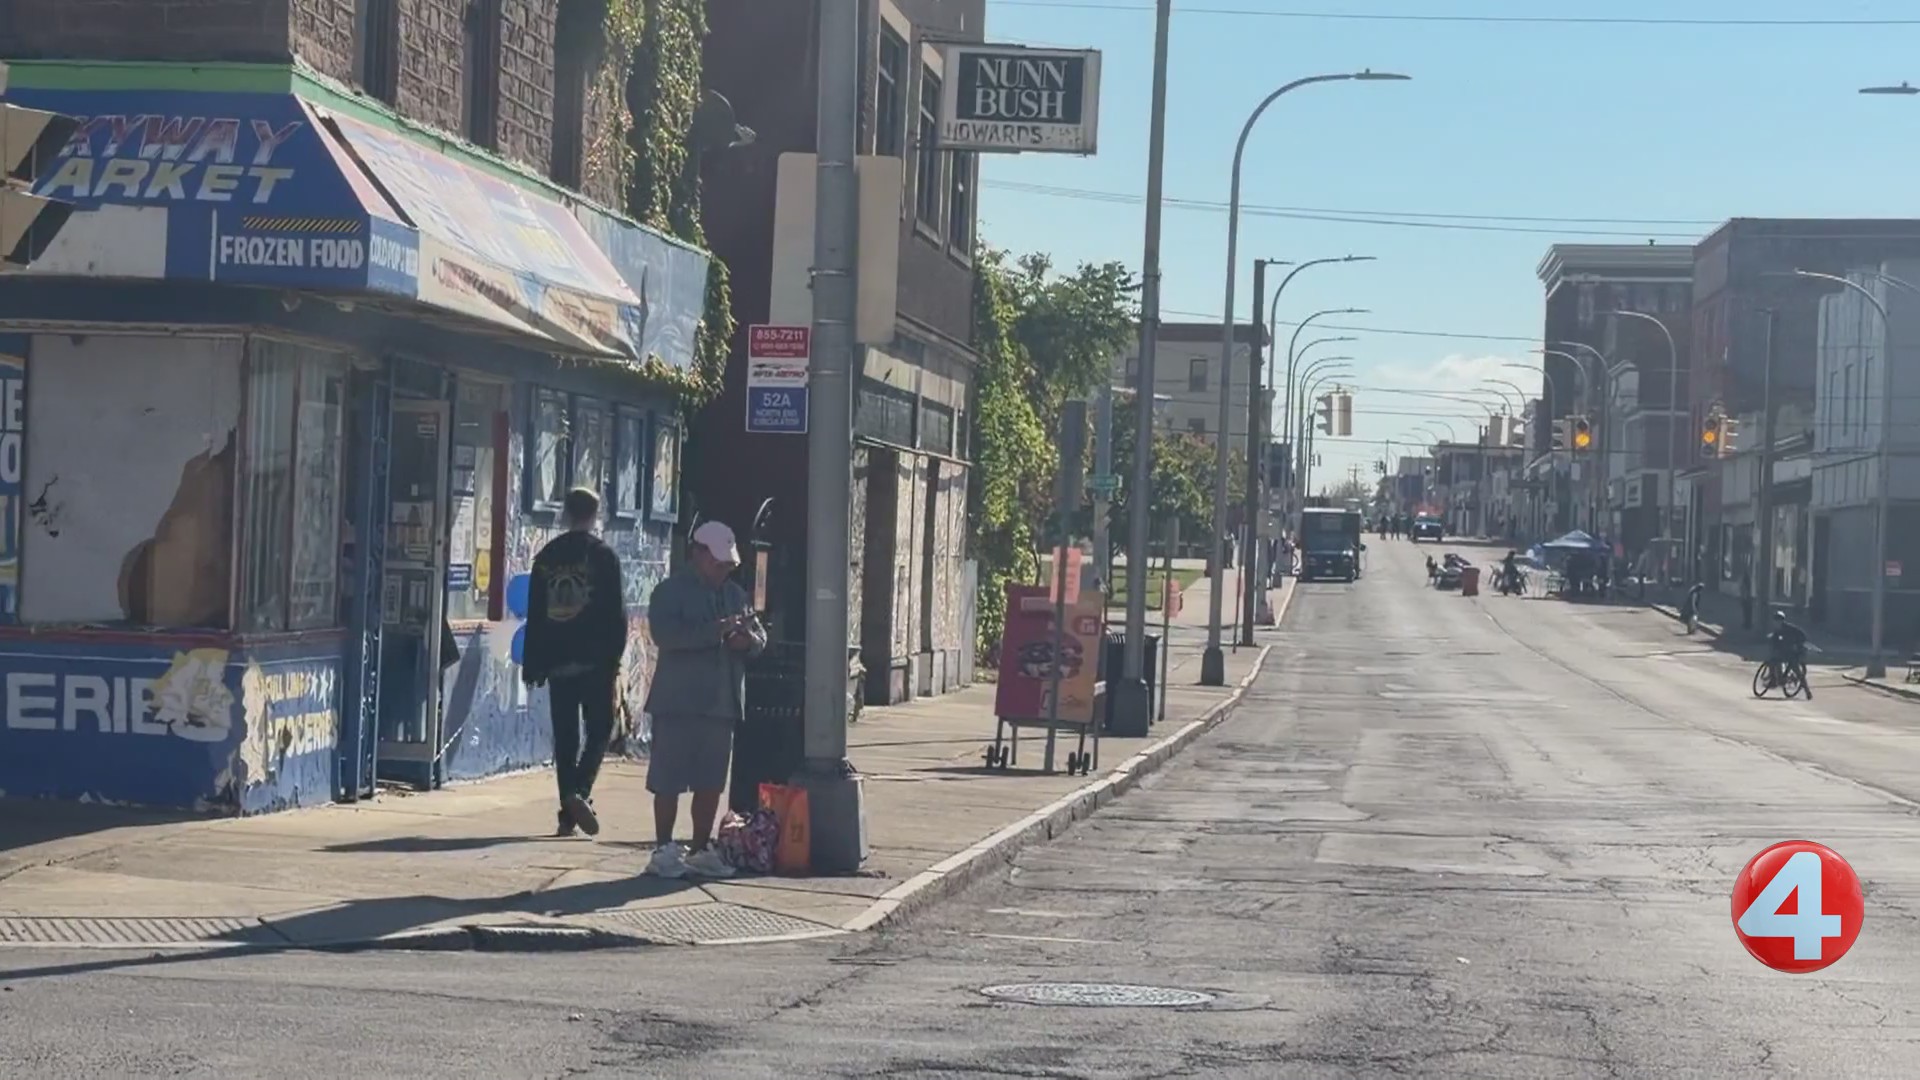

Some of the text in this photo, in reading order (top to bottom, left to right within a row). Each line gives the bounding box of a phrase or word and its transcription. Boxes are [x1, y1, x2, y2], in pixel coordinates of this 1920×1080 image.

[975, 58, 1067, 89] NUNN
[974, 87, 1066, 119] BUSH
[220, 235, 364, 268] FROZEN FOOD
[763, 392, 791, 407] 52A
